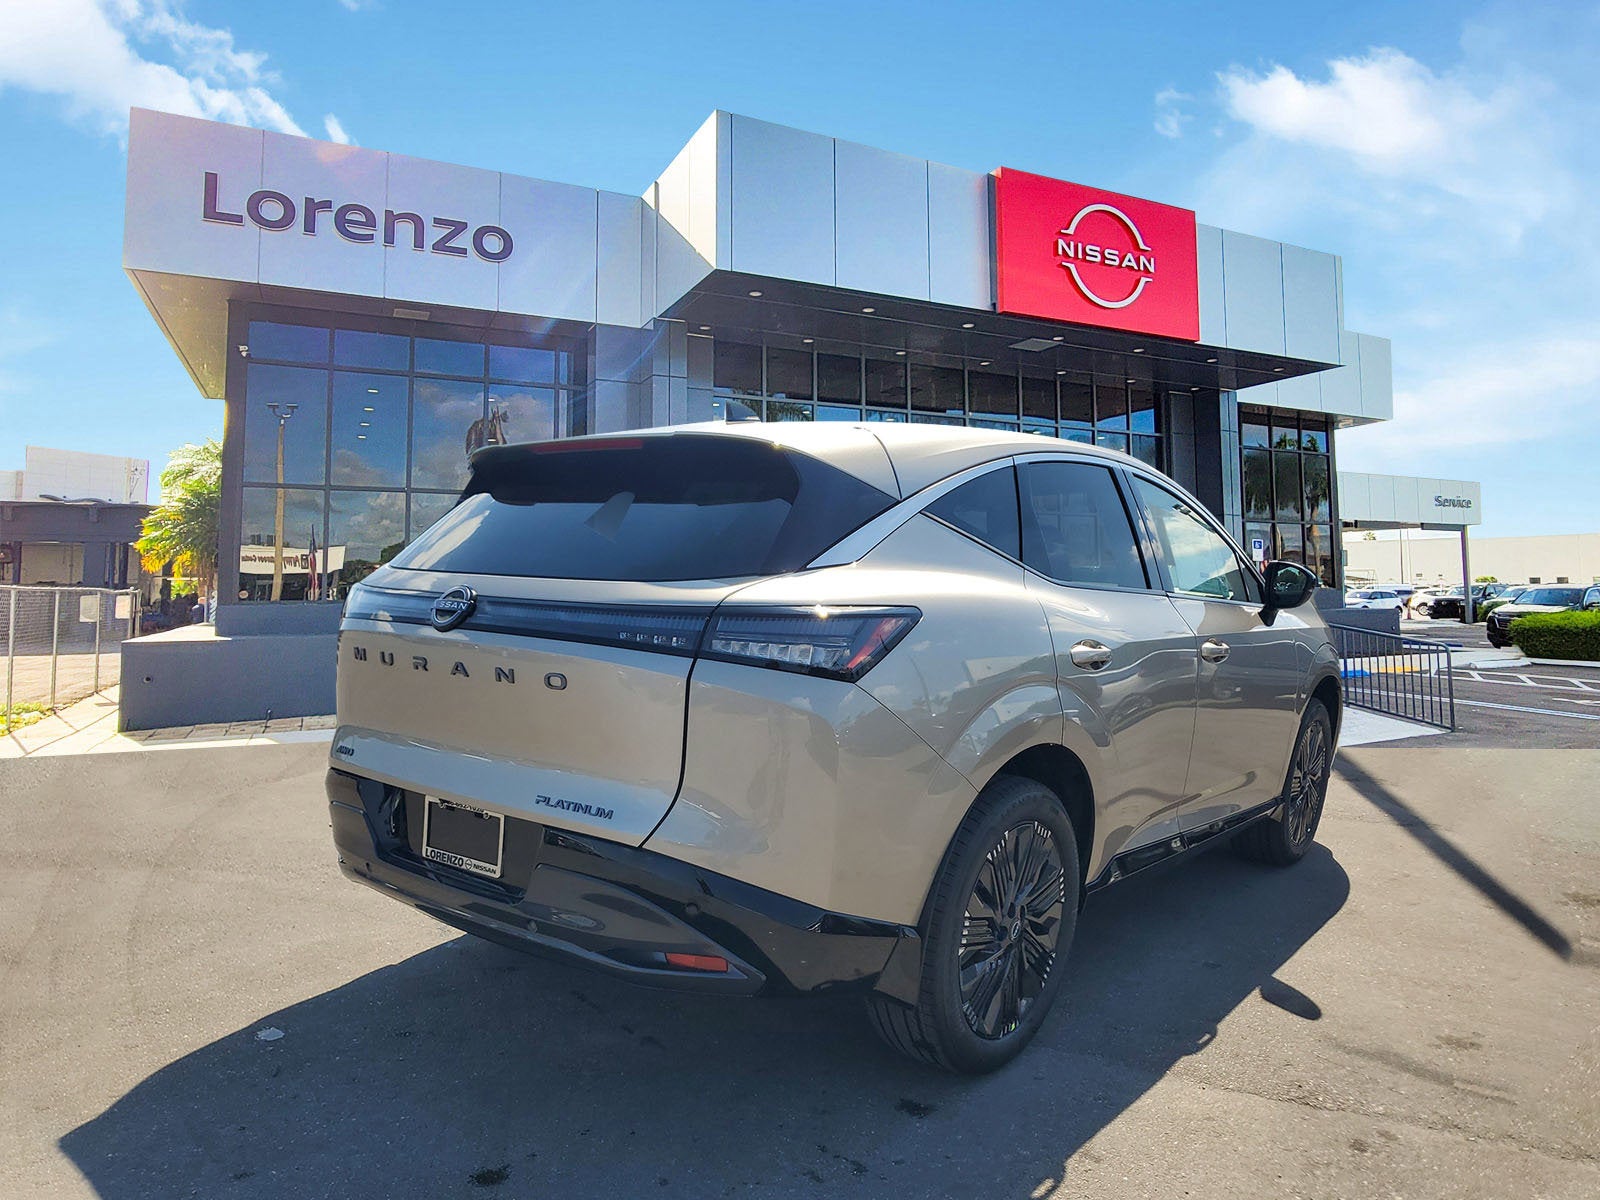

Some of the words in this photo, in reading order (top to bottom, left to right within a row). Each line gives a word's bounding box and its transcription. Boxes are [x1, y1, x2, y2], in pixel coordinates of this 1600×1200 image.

[203, 171, 514, 262] Lorenzo
[1057, 238, 1155, 273] NISSAN
[1434, 495, 1472, 508] Service
[436, 600, 468, 610] SSAN
[353, 646, 568, 691] MURANO
[534, 794, 615, 820] PLATINUM
[425, 848, 464, 867] LORENZO
[473, 863, 497, 875] NISSAN
